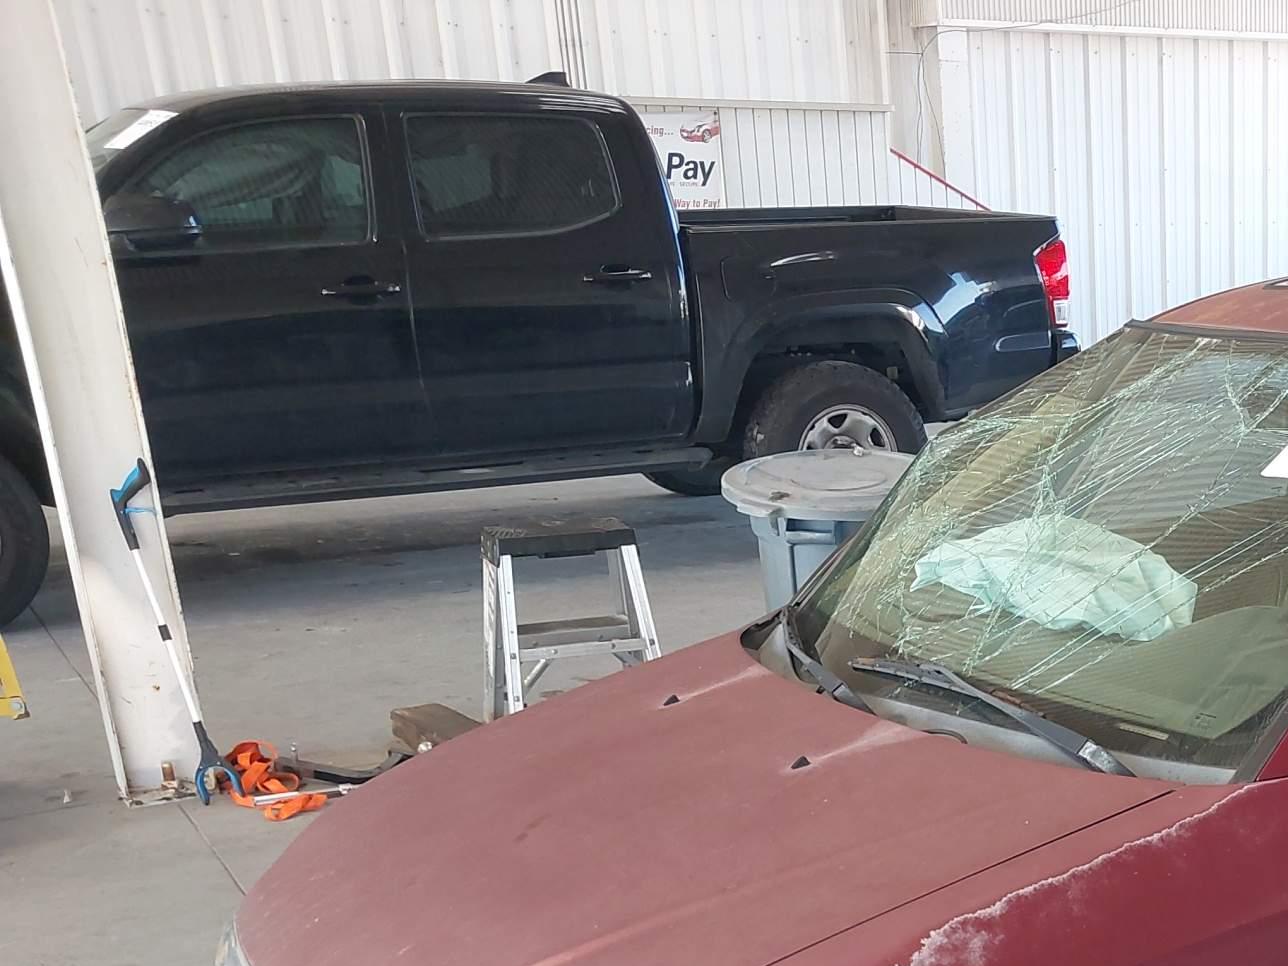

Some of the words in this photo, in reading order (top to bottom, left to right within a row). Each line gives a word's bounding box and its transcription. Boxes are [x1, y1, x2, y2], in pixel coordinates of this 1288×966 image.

[666, 152, 716, 187] Pay
[673, 198, 690, 209] Way
[693, 199, 701, 208] to
